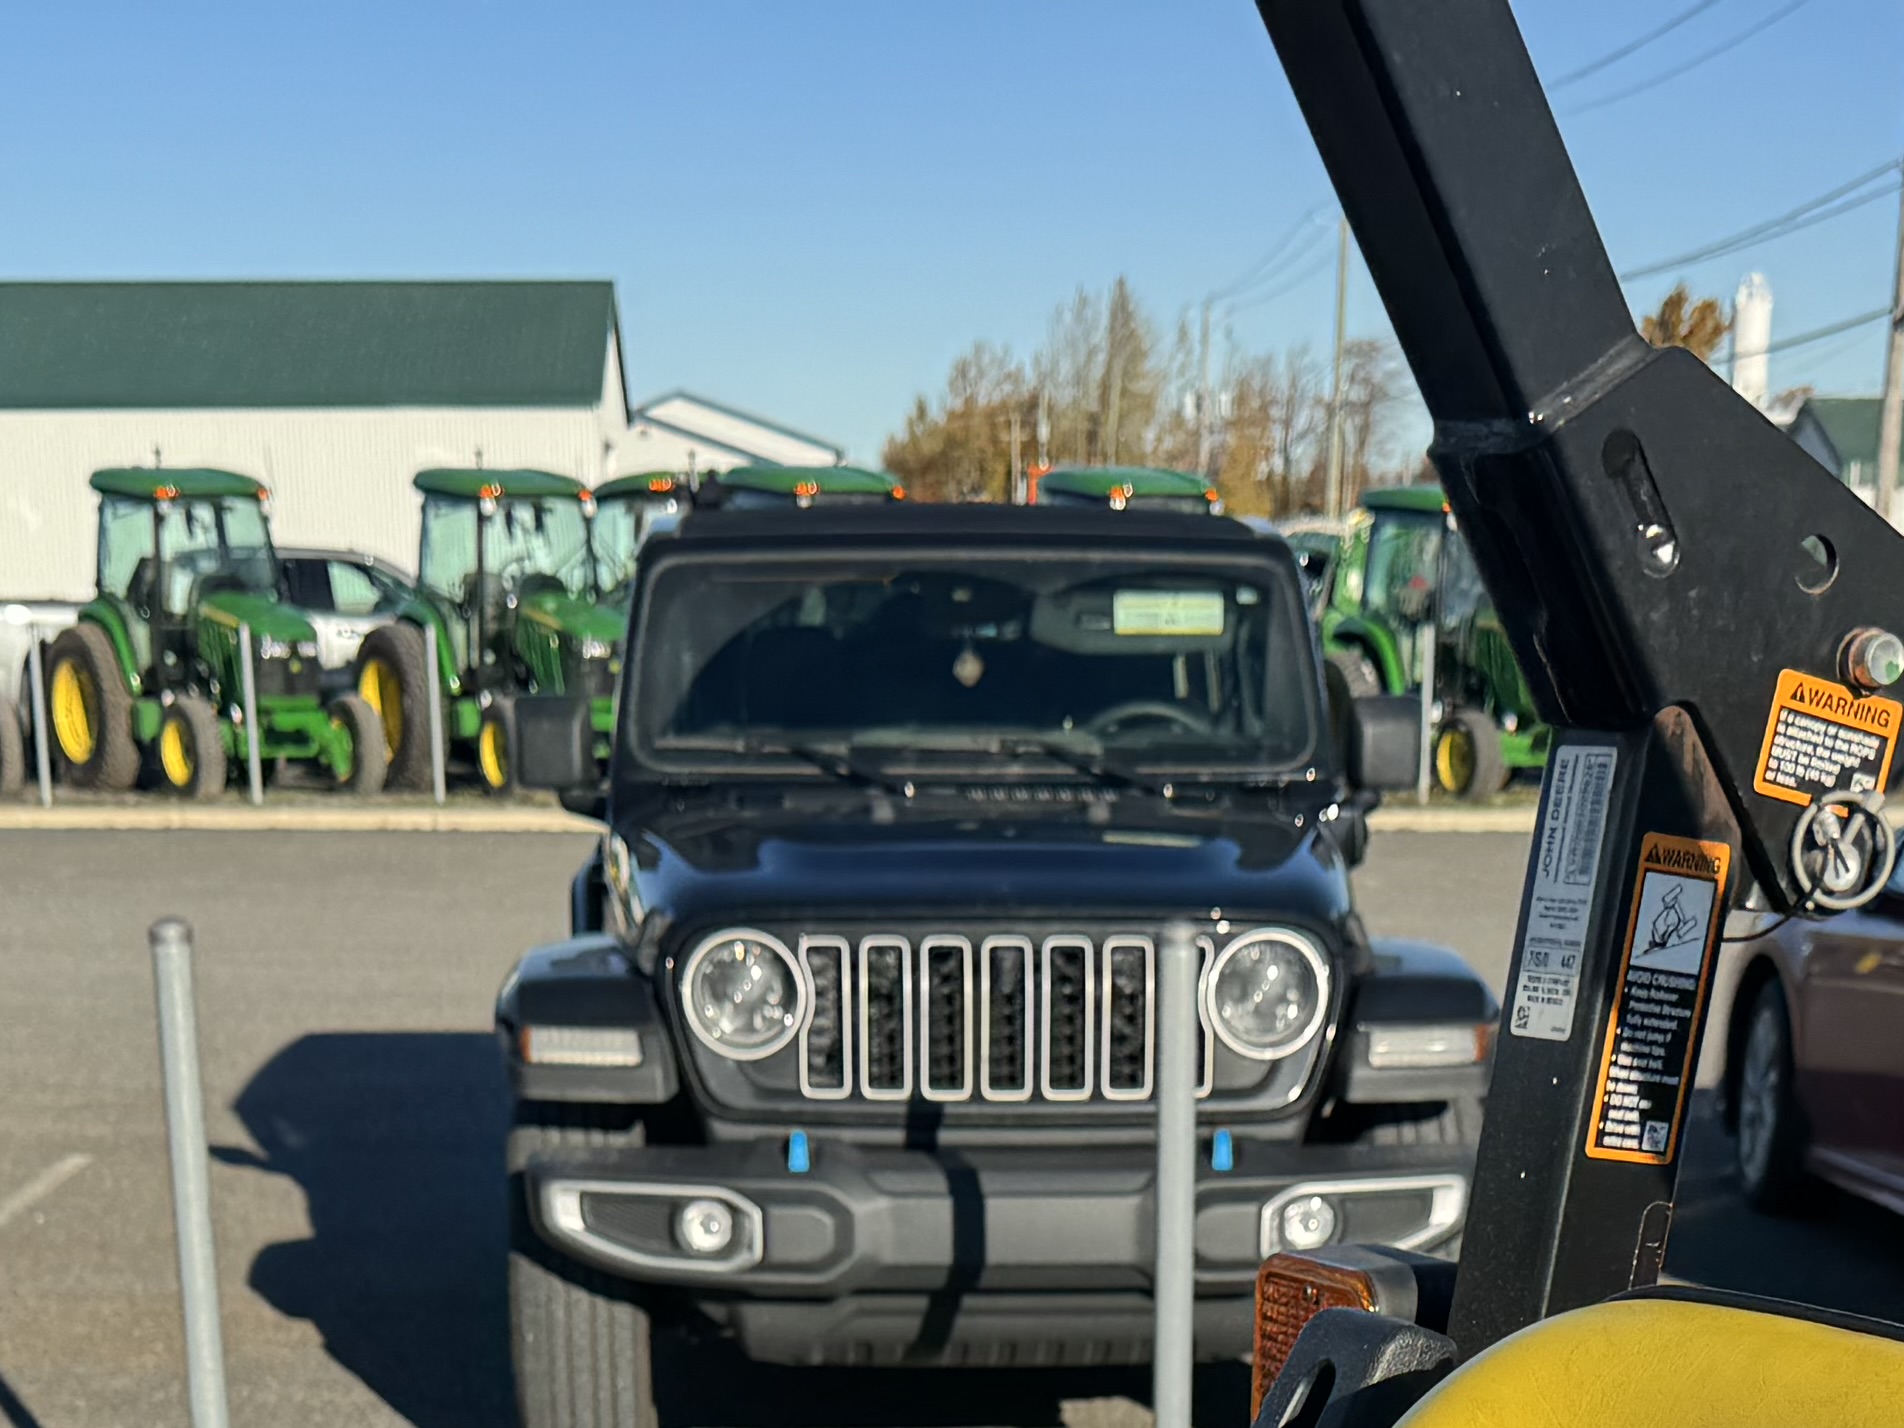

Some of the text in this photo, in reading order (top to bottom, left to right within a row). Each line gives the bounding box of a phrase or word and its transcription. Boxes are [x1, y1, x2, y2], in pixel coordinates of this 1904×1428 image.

[1809, 687, 1891, 728] WARNING
[1542, 759, 1569, 878] JOHN DEERE
[1662, 847, 1721, 874] WARNING
